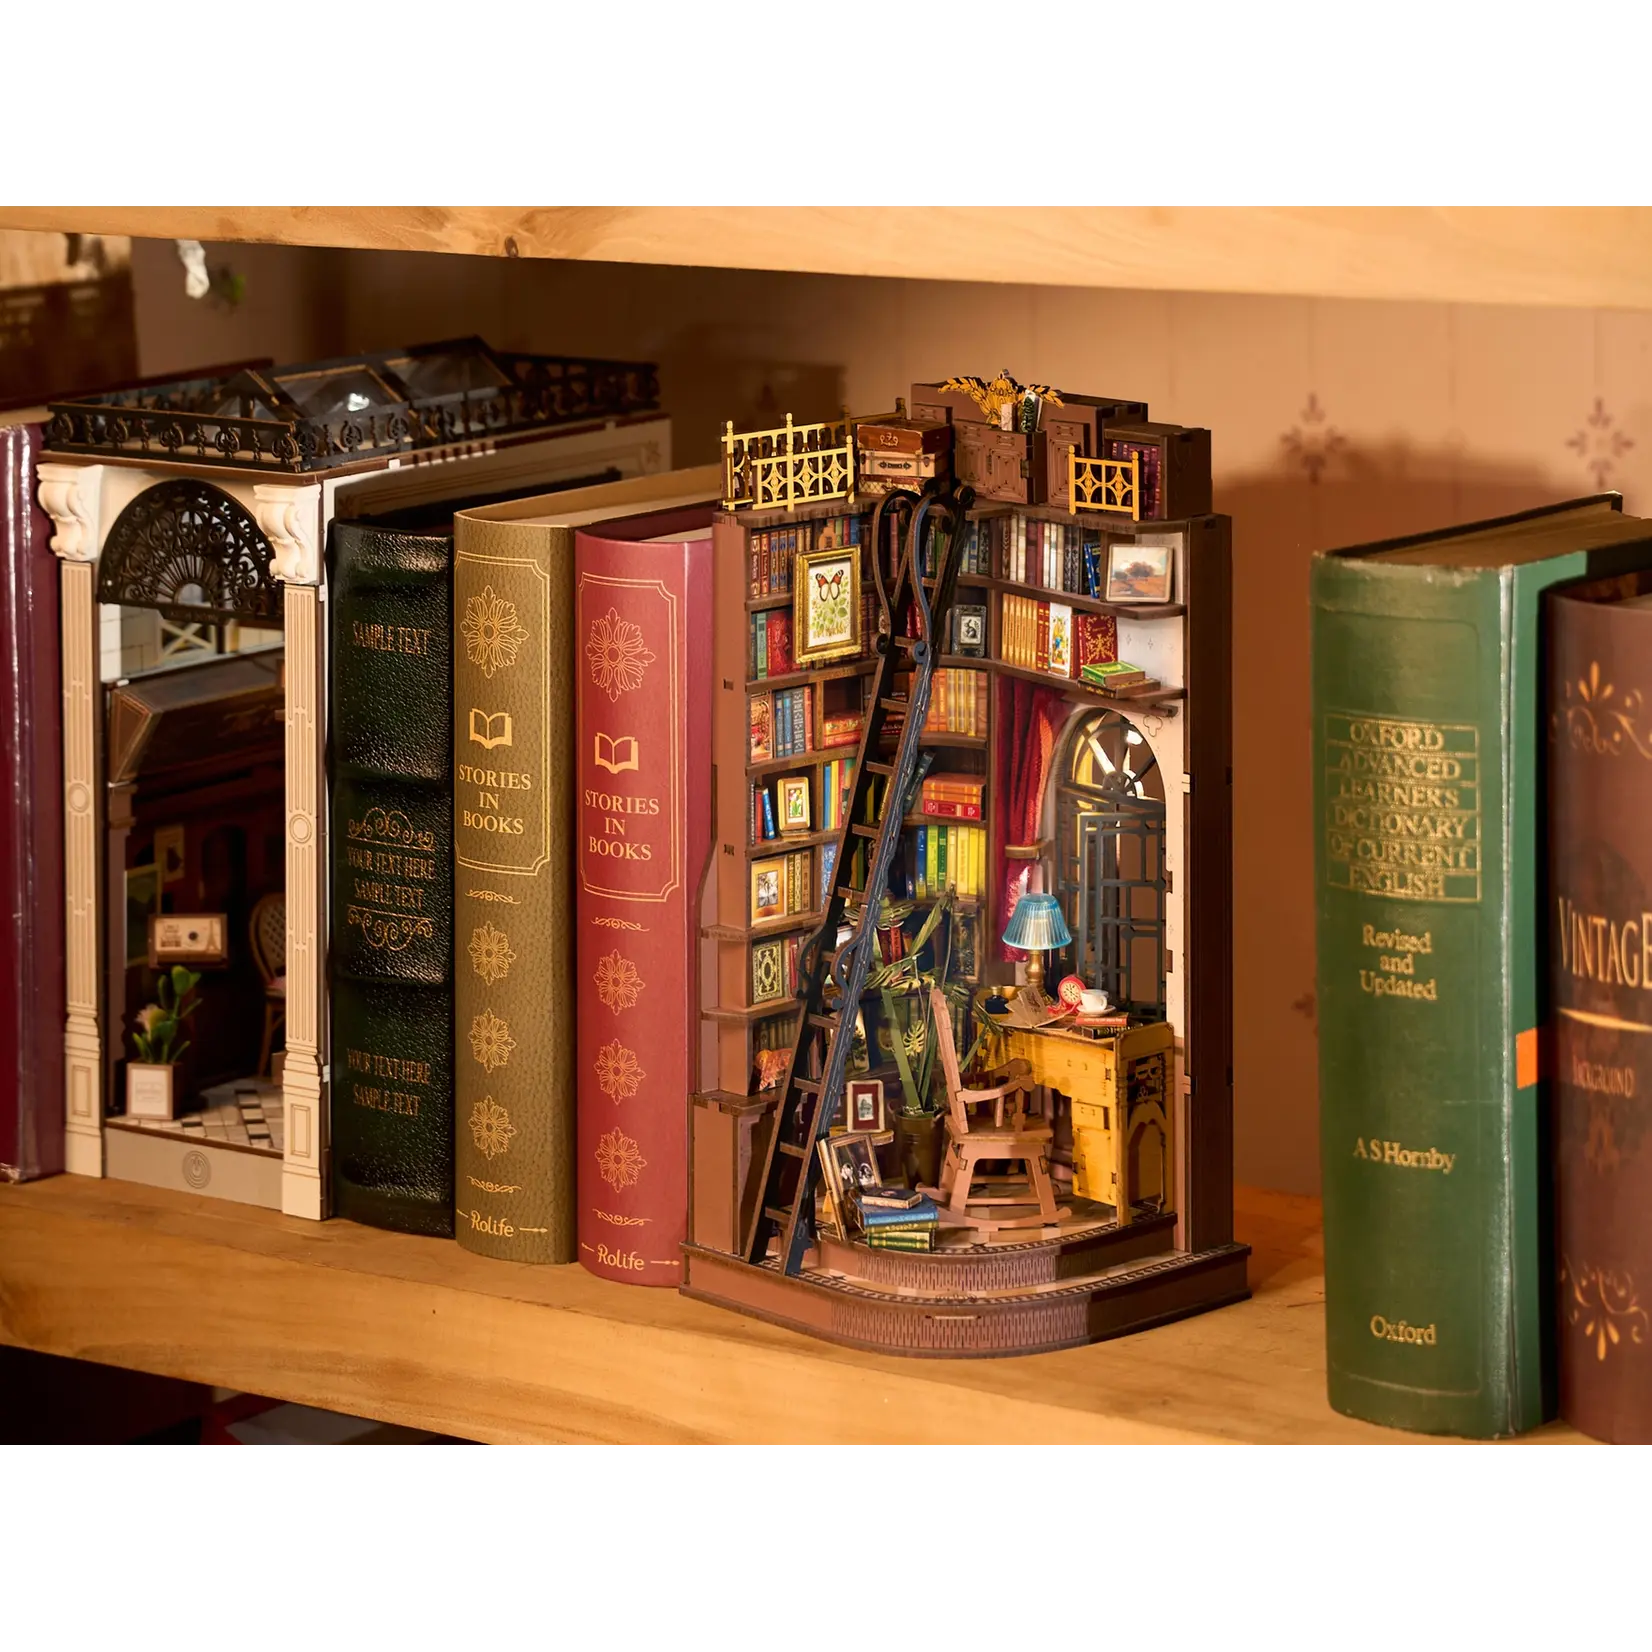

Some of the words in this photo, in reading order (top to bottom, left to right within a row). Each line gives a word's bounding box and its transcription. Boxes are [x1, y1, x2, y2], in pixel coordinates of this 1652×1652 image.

[352, 620, 396, 651] SAMPLE
[397, 626, 431, 655] TEXT
[1350, 722, 1444, 751] OXFORD
[459, 764, 532, 790] STORIES
[1340, 750, 1461, 780] ADVANCED
[479, 791, 500, 810] IN
[585, 789, 660, 815] STORIES
[463, 810, 524, 835] BOOKS
[604, 817, 625, 836] IN
[1334, 804, 1469, 839] DICTIONARY
[589, 836, 652, 861] BOOKS
[1357, 838, 1474, 870] CURRENT
[375, 852, 402, 876] TEXT
[405, 857, 436, 880] HERE
[1349, 864, 1445, 898] ENGLISH
[1362, 924, 1433, 955] Revised
[1558, 896, 1652, 990] VINTAGE
[1379, 953, 1415, 975] and
[1359, 969, 1438, 1001] Updated
[373, 1055, 400, 1080] TEXT
[402, 1060, 431, 1085] HERE
[391, 1092, 421, 1117] TEXT
[471, 1210, 514, 1237] Rolife
[597, 1243, 645, 1271] Rolife
[1370, 1314, 1437, 1346] Oxford
